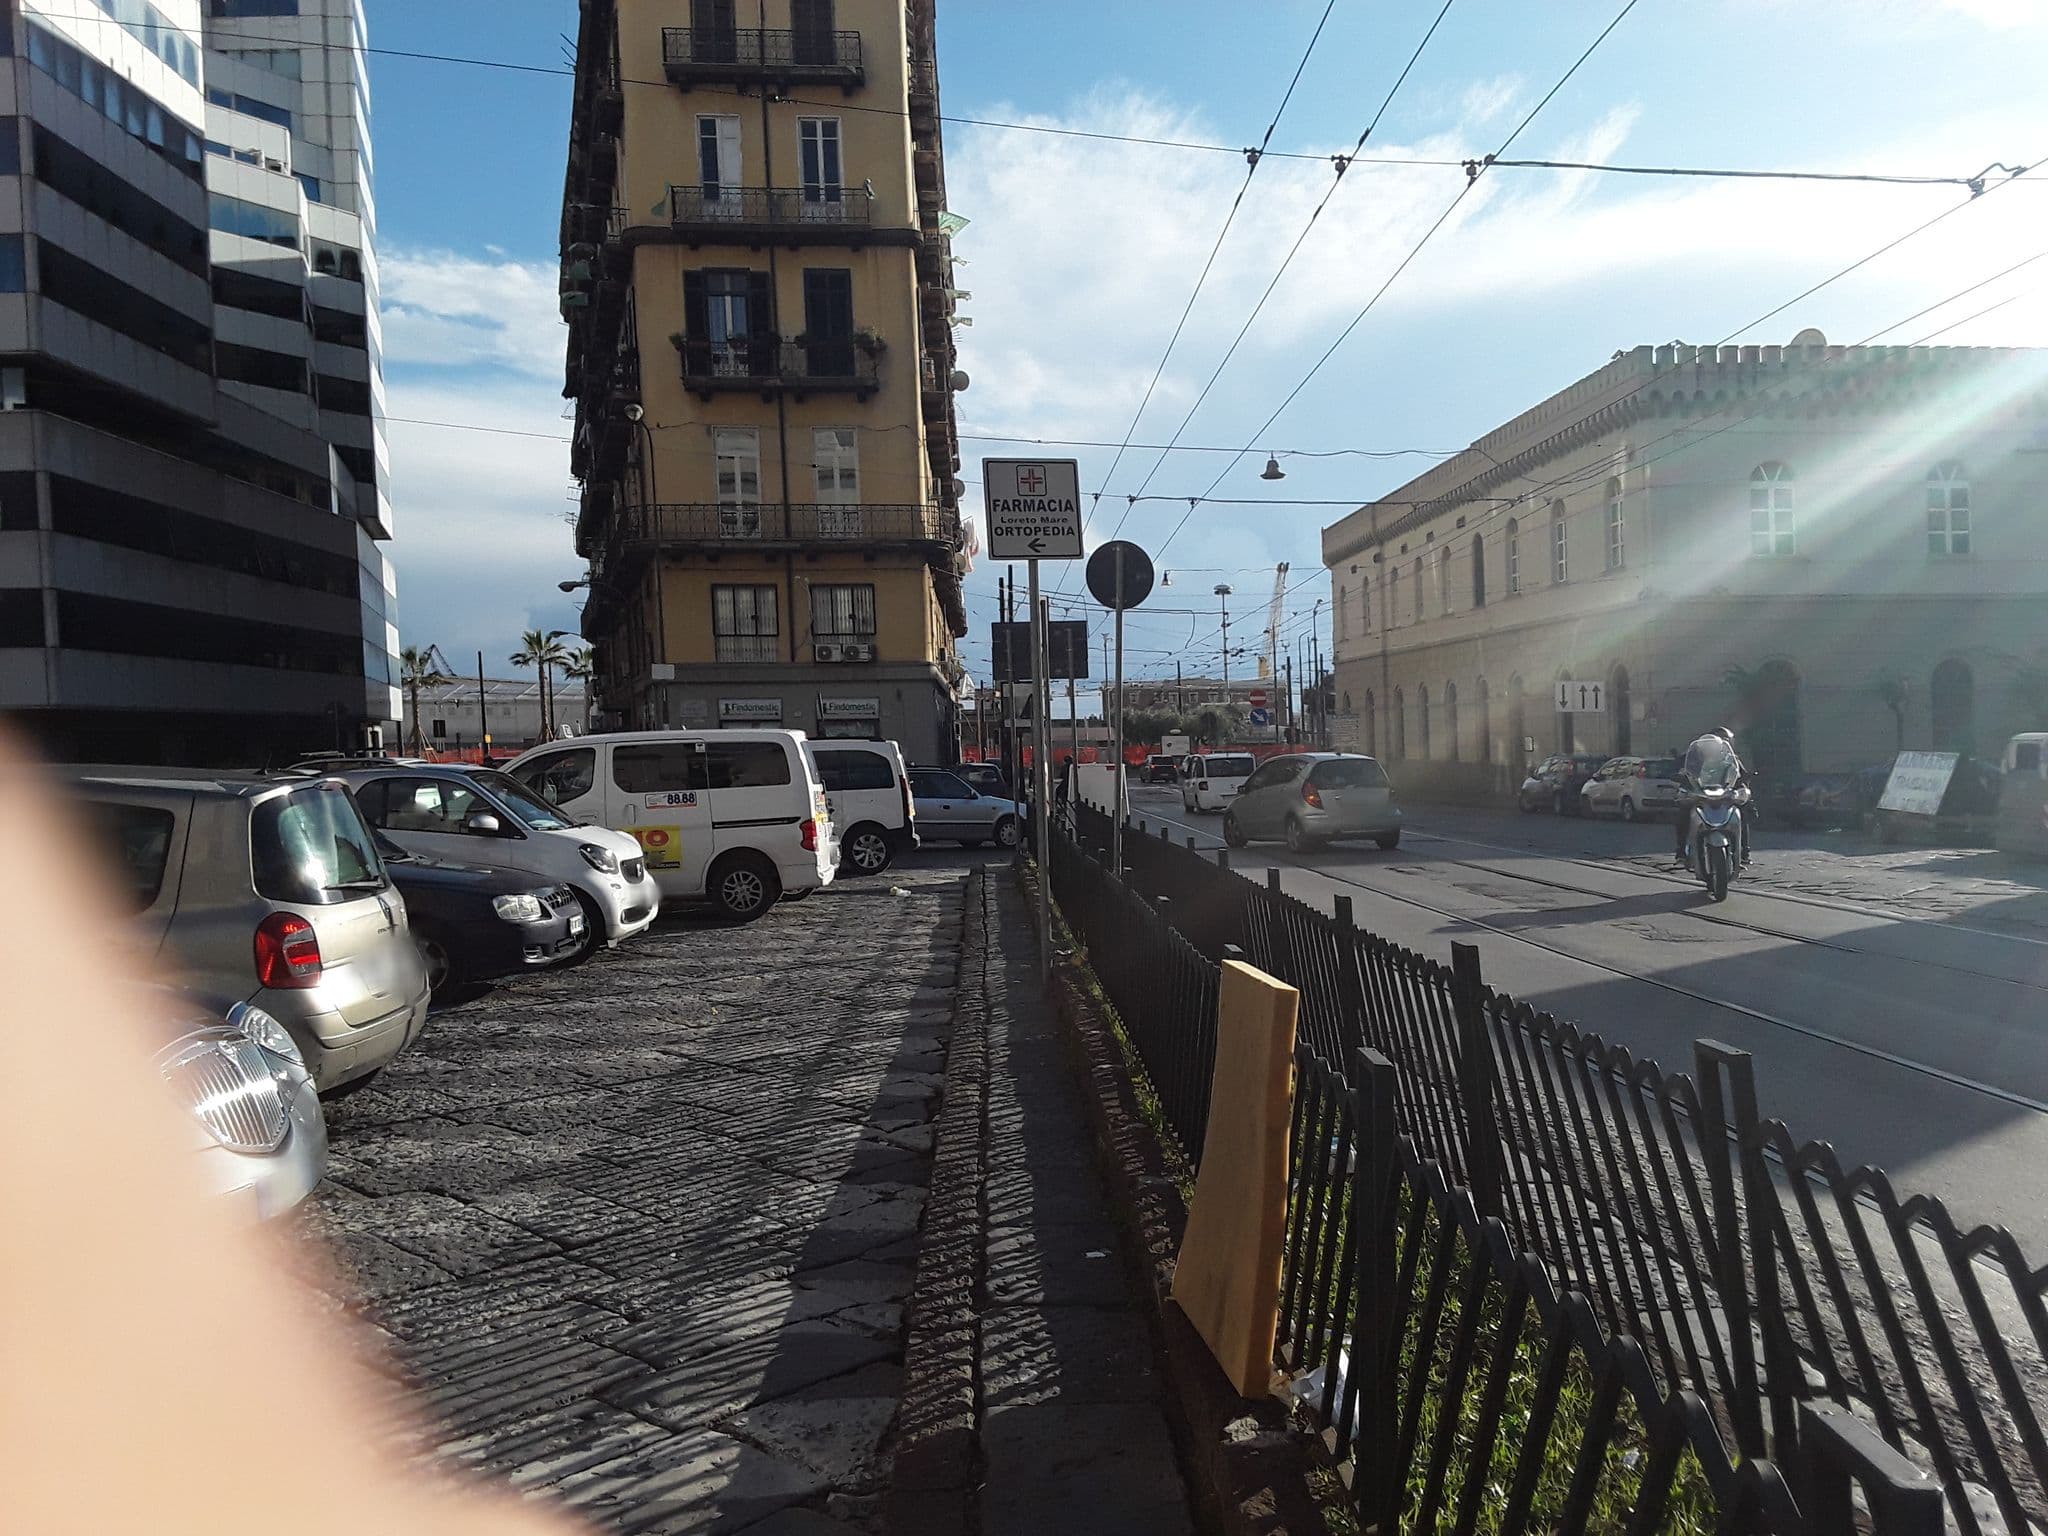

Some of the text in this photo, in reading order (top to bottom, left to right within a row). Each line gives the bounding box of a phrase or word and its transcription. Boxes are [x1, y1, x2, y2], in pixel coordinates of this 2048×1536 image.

[992, 499, 1075, 512] FARMACIA
[1000, 516, 1068, 524] Loreto Mare
[994, 526, 1075, 537] ORTOPEDIA
[732, 703, 779, 712] Findomestic
[828, 703, 877, 712] Findomestic
